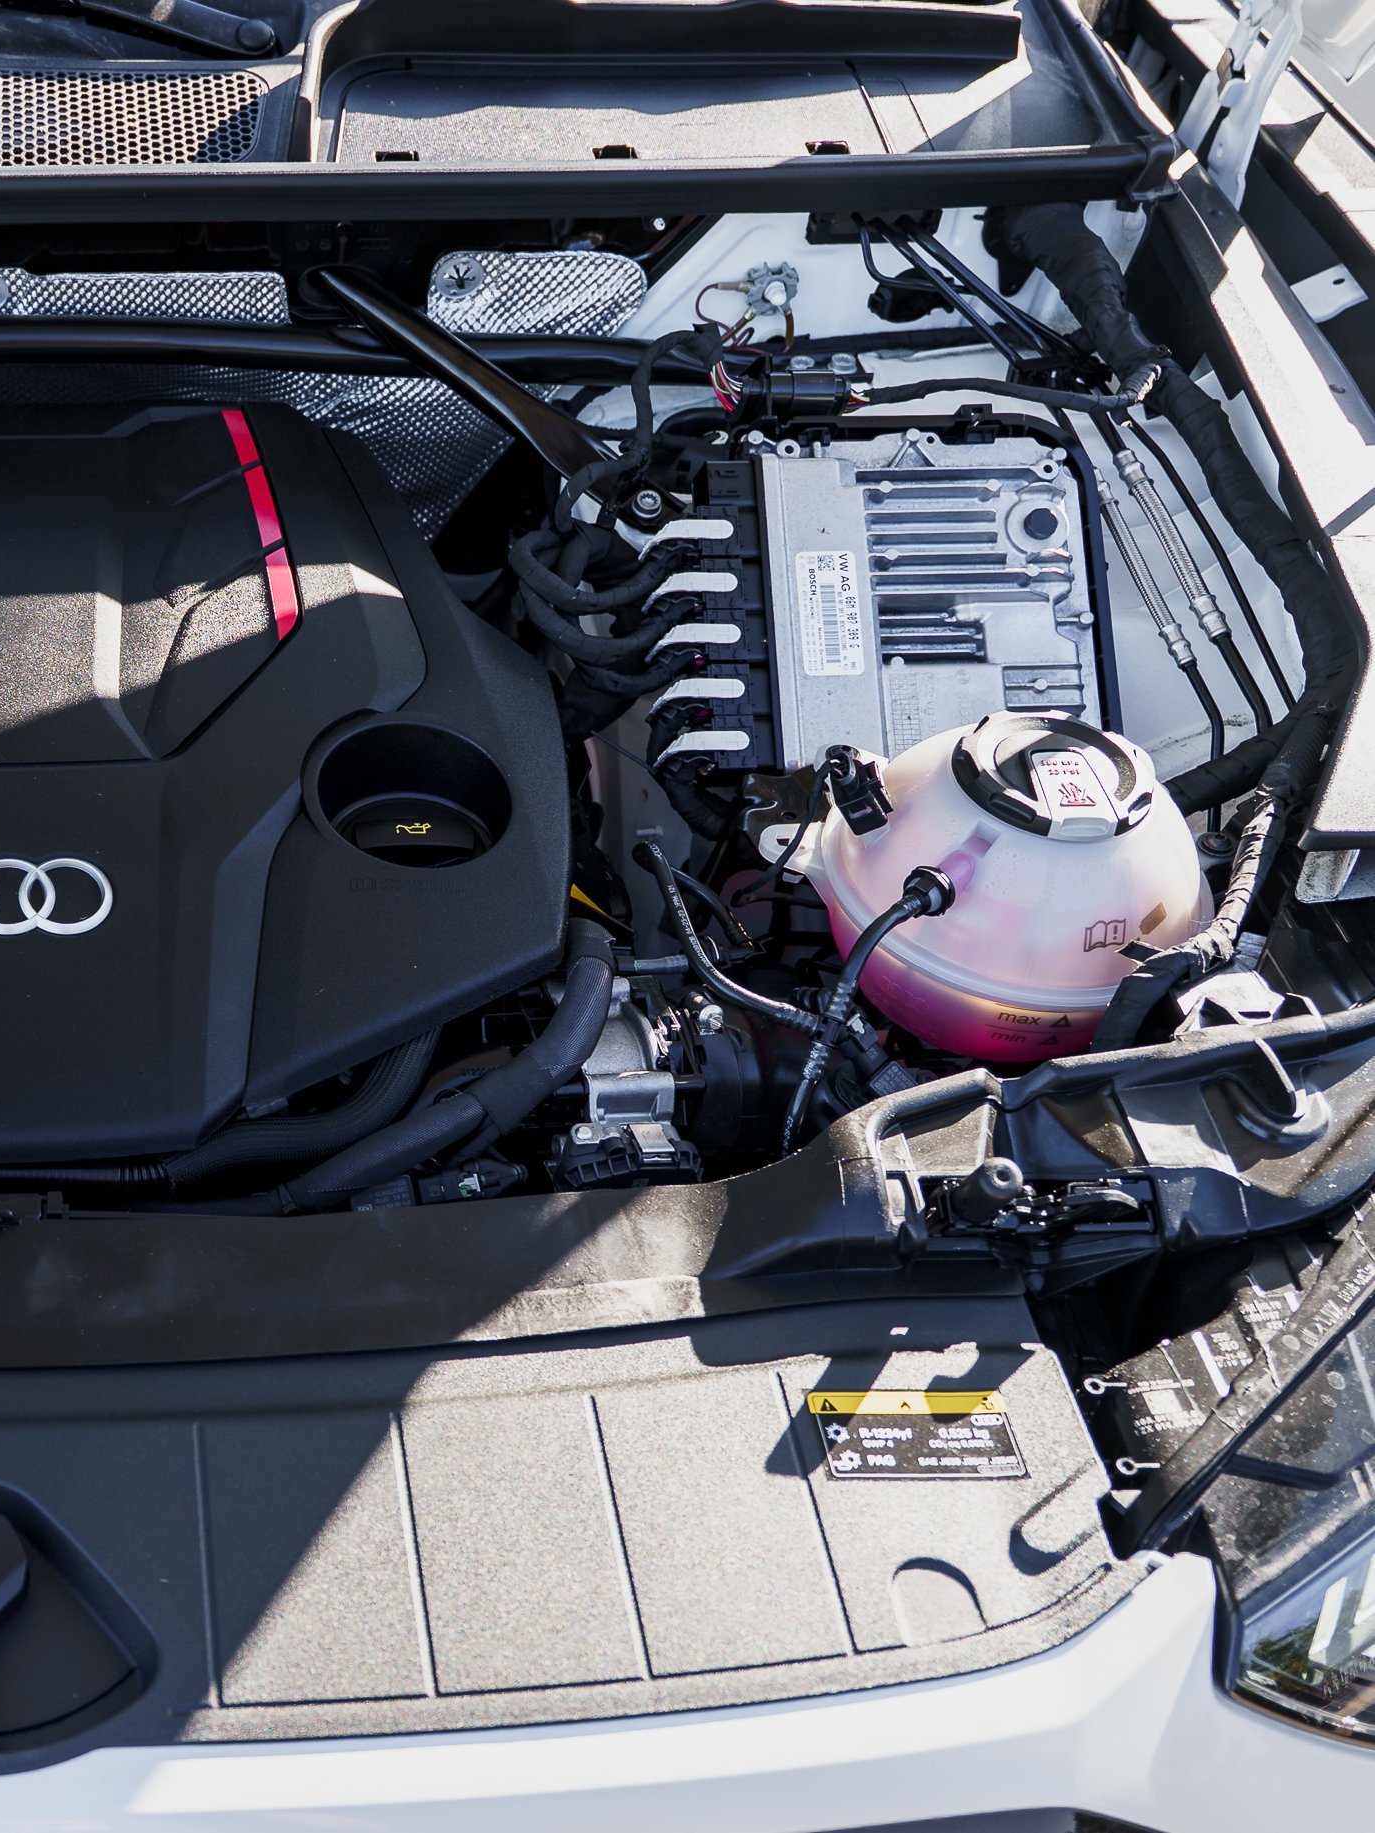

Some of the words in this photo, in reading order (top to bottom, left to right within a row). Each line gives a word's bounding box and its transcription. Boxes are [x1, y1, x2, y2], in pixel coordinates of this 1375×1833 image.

[838, 553, 849, 572] VW
[808, 568, 817, 596] BOSCH
[840, 575, 851, 592] AG
[846, 612, 858, 624] 907
[997, 1012, 1042, 1026] max
[990, 1032, 1027, 1043] min
